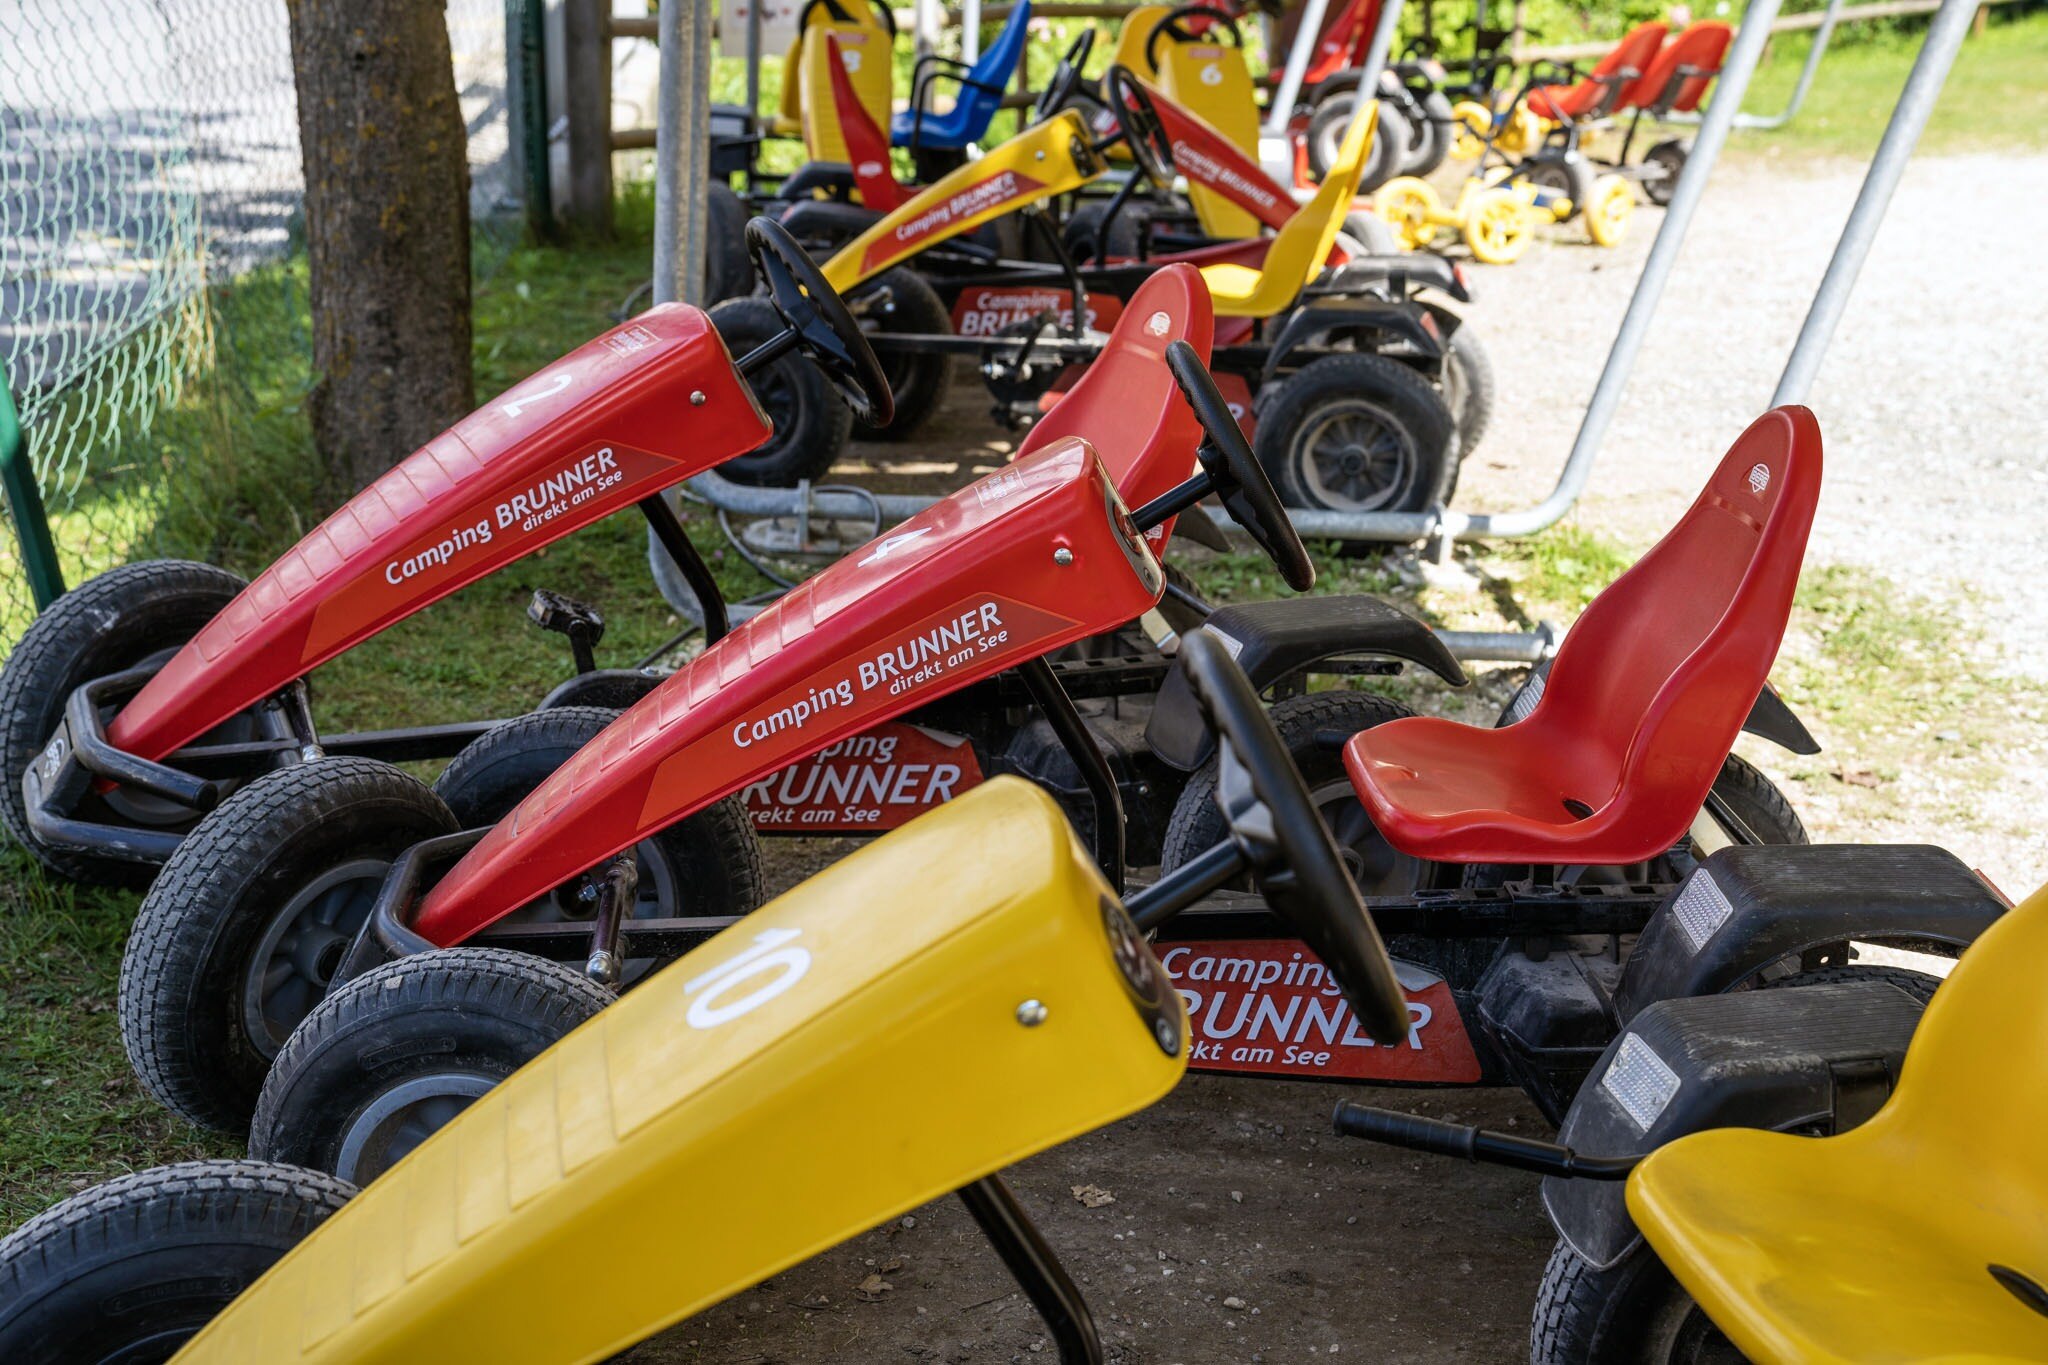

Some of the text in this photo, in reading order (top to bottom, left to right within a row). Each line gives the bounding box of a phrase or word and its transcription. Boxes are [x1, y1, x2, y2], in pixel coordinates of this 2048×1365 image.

[1201, 63, 1222, 86] 6
[896, 206, 950, 240] Camping
[950, 172, 1015, 215] BRUNNER
[977, 291, 1060, 312] Camping
[502, 374, 572, 418] 2
[385, 447, 618, 585] Camping BRUNNER
[523, 470, 623, 532] direkt am See
[733, 602, 1002, 748] Camping BRUNNER
[890, 630, 1008, 696] direkt am See
[741, 764, 961, 805] RUNNER
[801, 812, 836, 823] am
[842, 806, 881, 822] See
[683, 928, 812, 1029] 10
[1231, 1047, 1273, 1063] am
[1282, 1046, 1331, 1066] See
